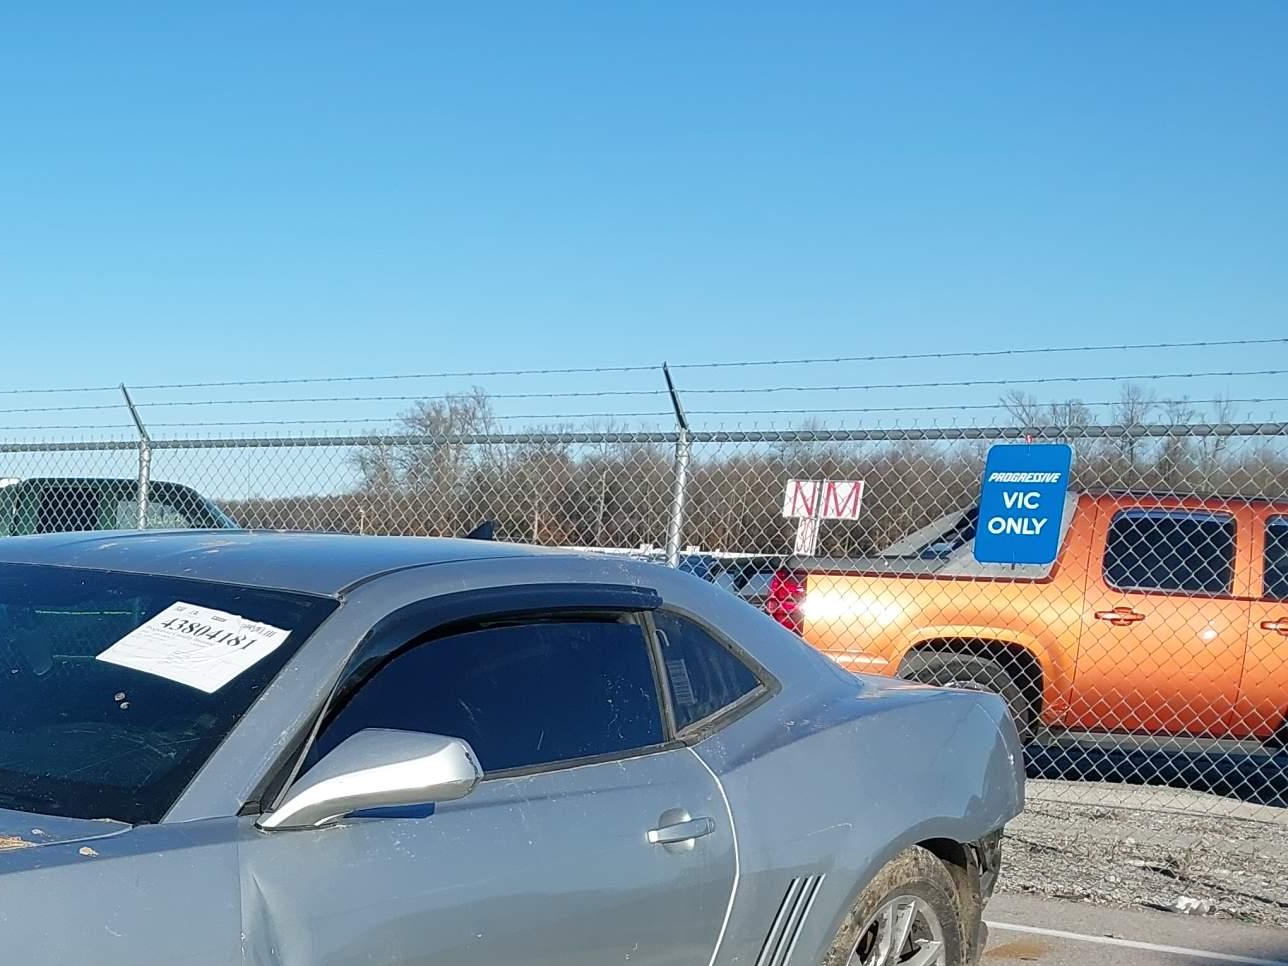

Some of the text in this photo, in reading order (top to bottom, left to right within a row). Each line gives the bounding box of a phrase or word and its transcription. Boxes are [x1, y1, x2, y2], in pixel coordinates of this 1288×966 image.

[988, 472, 1062, 483] PROGRESSIVE
[1003, 491, 1041, 509] VIC
[987, 516, 1048, 535] ONLY
[161, 617, 258, 650] 43804181
